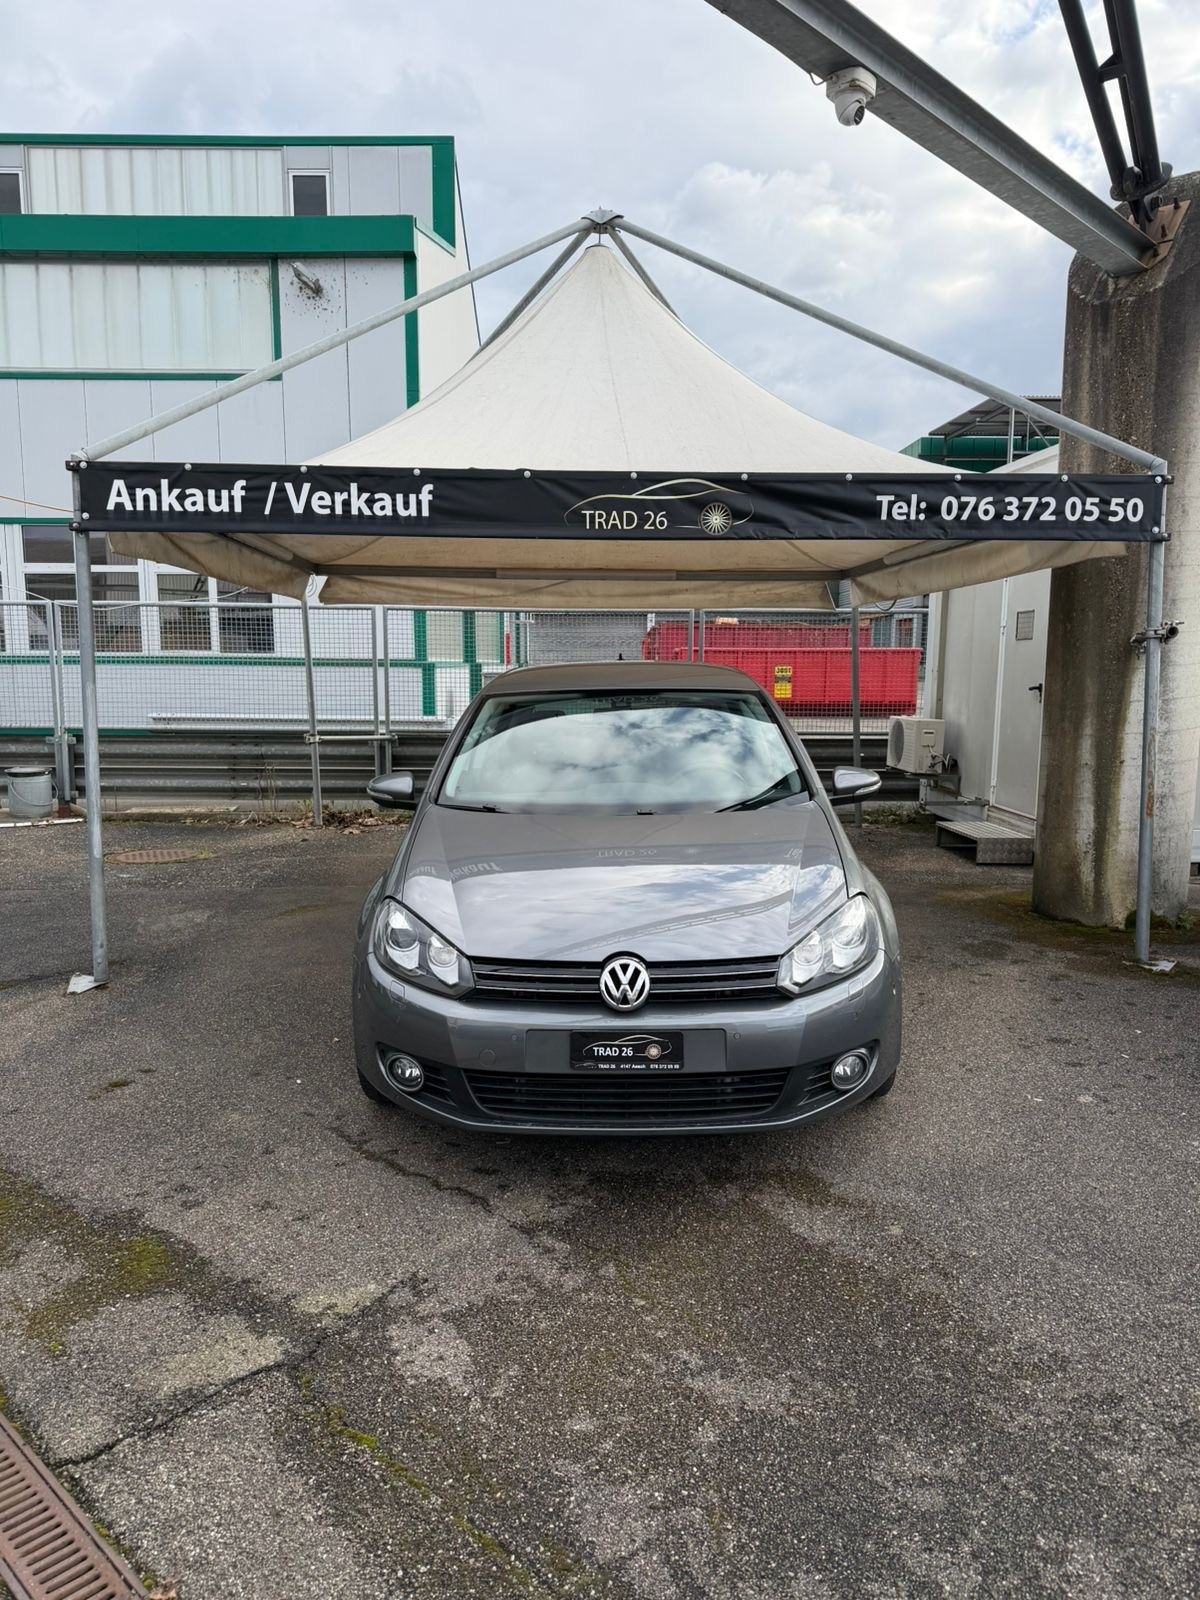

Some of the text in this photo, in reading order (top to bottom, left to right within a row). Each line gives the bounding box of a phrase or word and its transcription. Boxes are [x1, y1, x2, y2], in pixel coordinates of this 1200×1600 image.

[106, 478, 246, 513] Ankauf
[876, 493, 1144, 523] Tel: 076 372 05 50
[581, 510, 668, 530] TRAD 26
[600, 957, 650, 1010] VW
[593, 1047, 633, 1056] TRAD 26
